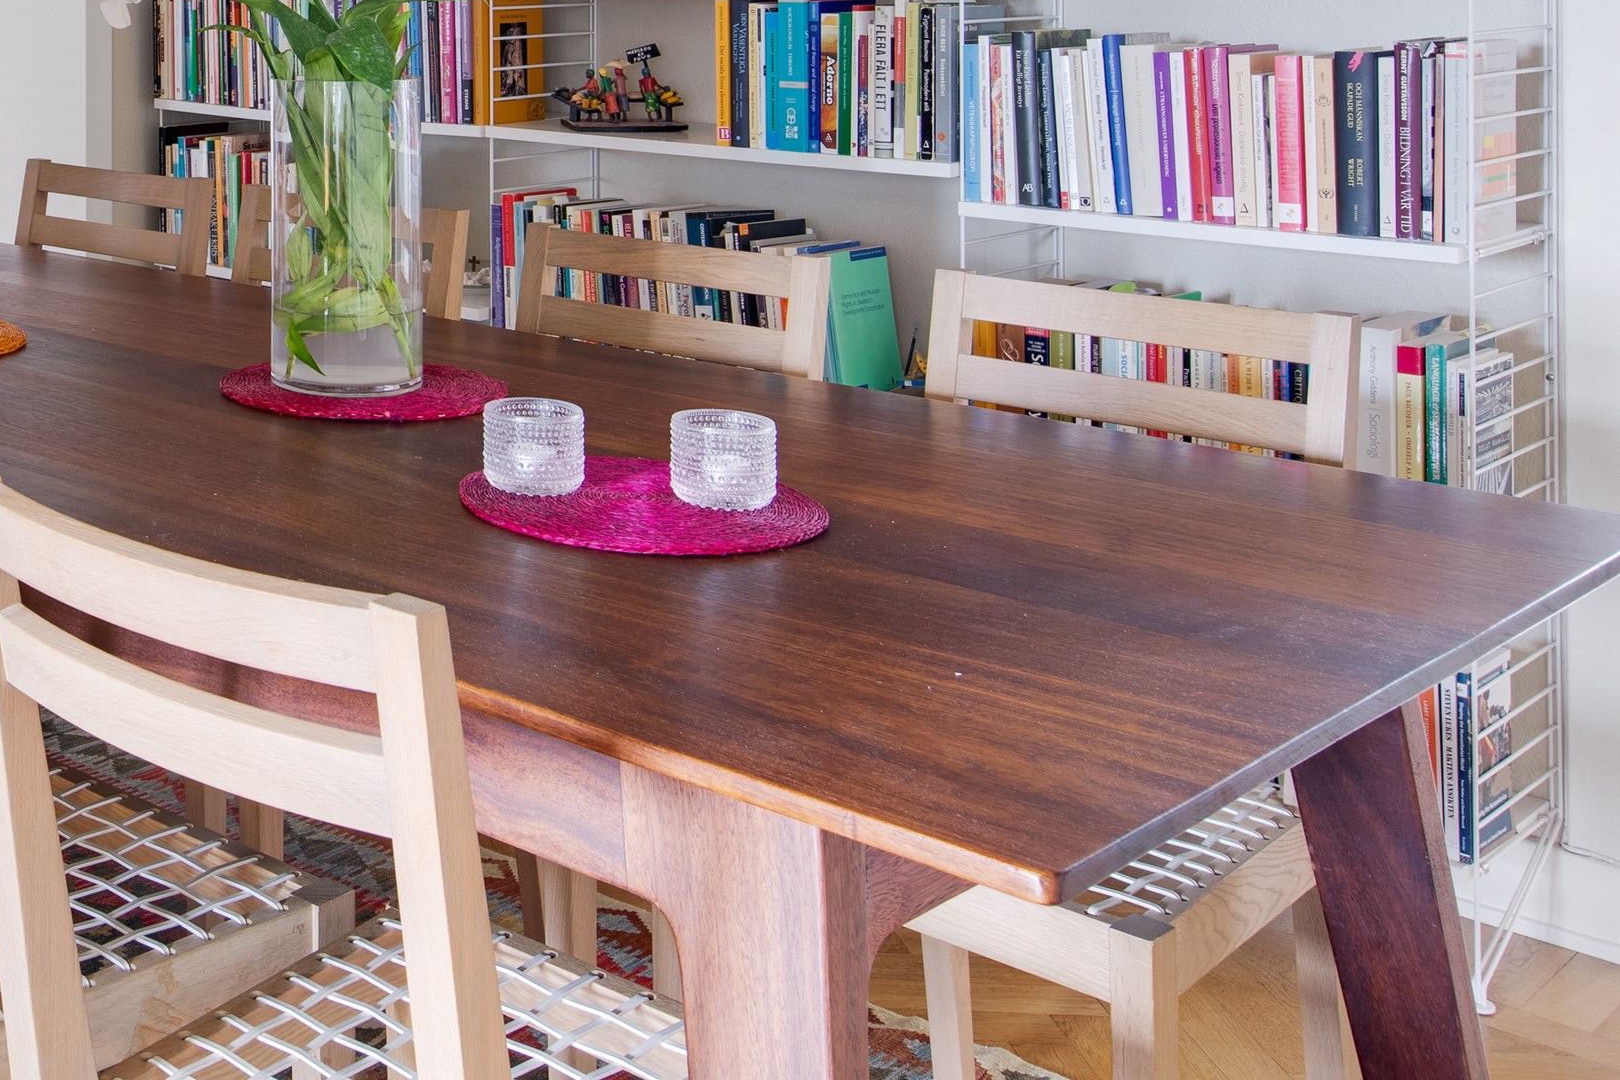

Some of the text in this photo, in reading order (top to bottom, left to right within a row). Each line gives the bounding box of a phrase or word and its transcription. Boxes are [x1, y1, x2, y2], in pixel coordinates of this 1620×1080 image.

[739, 28, 747, 73] VÄSENTLIGA
[876, 25, 889, 111] FLERA FÄLT ETT
[1023, 50, 1031, 82] Sven-Eric
[826, 56, 835, 105] Adorno
[1356, 100, 1364, 141] MÄNNISKAN
[1383, 74, 1391, 167] Tomas Kroksmark Didaskalos
[1399, 127, 1410, 178] BILDNING
[1400, 189, 1414, 209] VÅR
[1400, 215, 1411, 233] TID
[1294, 370, 1303, 403] CRITIQ
[1432, 358, 1440, 401] LANGUAGE
[1367, 346, 1380, 459] Anthony Giddens Sociologi
[1445, 746, 1454, 781] MAKTENS
[1446, 783, 1455, 818] ANSIKTEN
